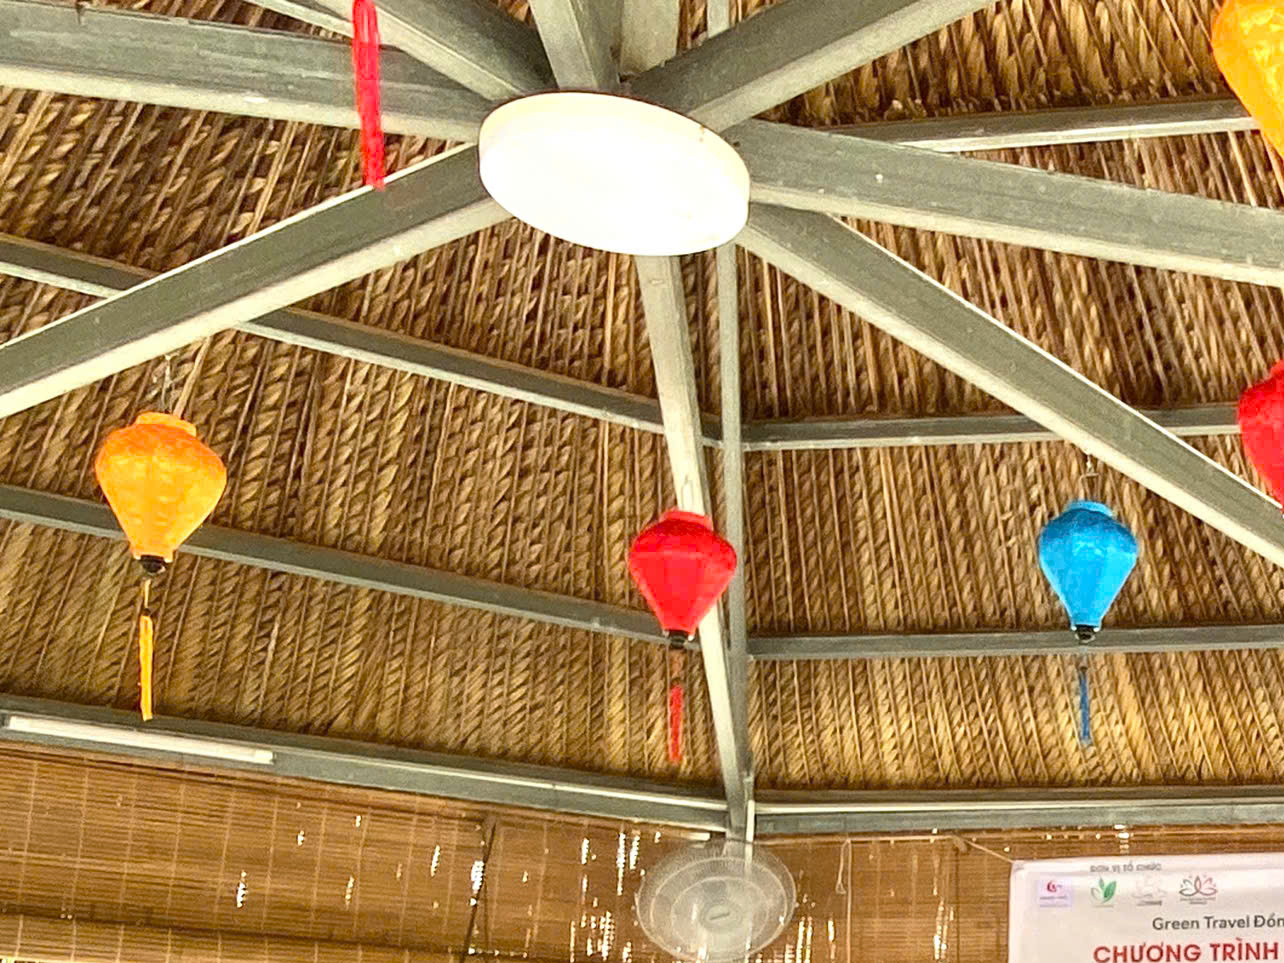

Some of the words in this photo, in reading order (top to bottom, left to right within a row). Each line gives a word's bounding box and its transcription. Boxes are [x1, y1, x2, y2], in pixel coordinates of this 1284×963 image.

[1152, 916, 1200, 930] Green
[1204, 914, 1251, 928] Travel
[1093, 941, 1201, 963] CHƯƠNG
[1210, 937, 1279, 962] TRÌNH
